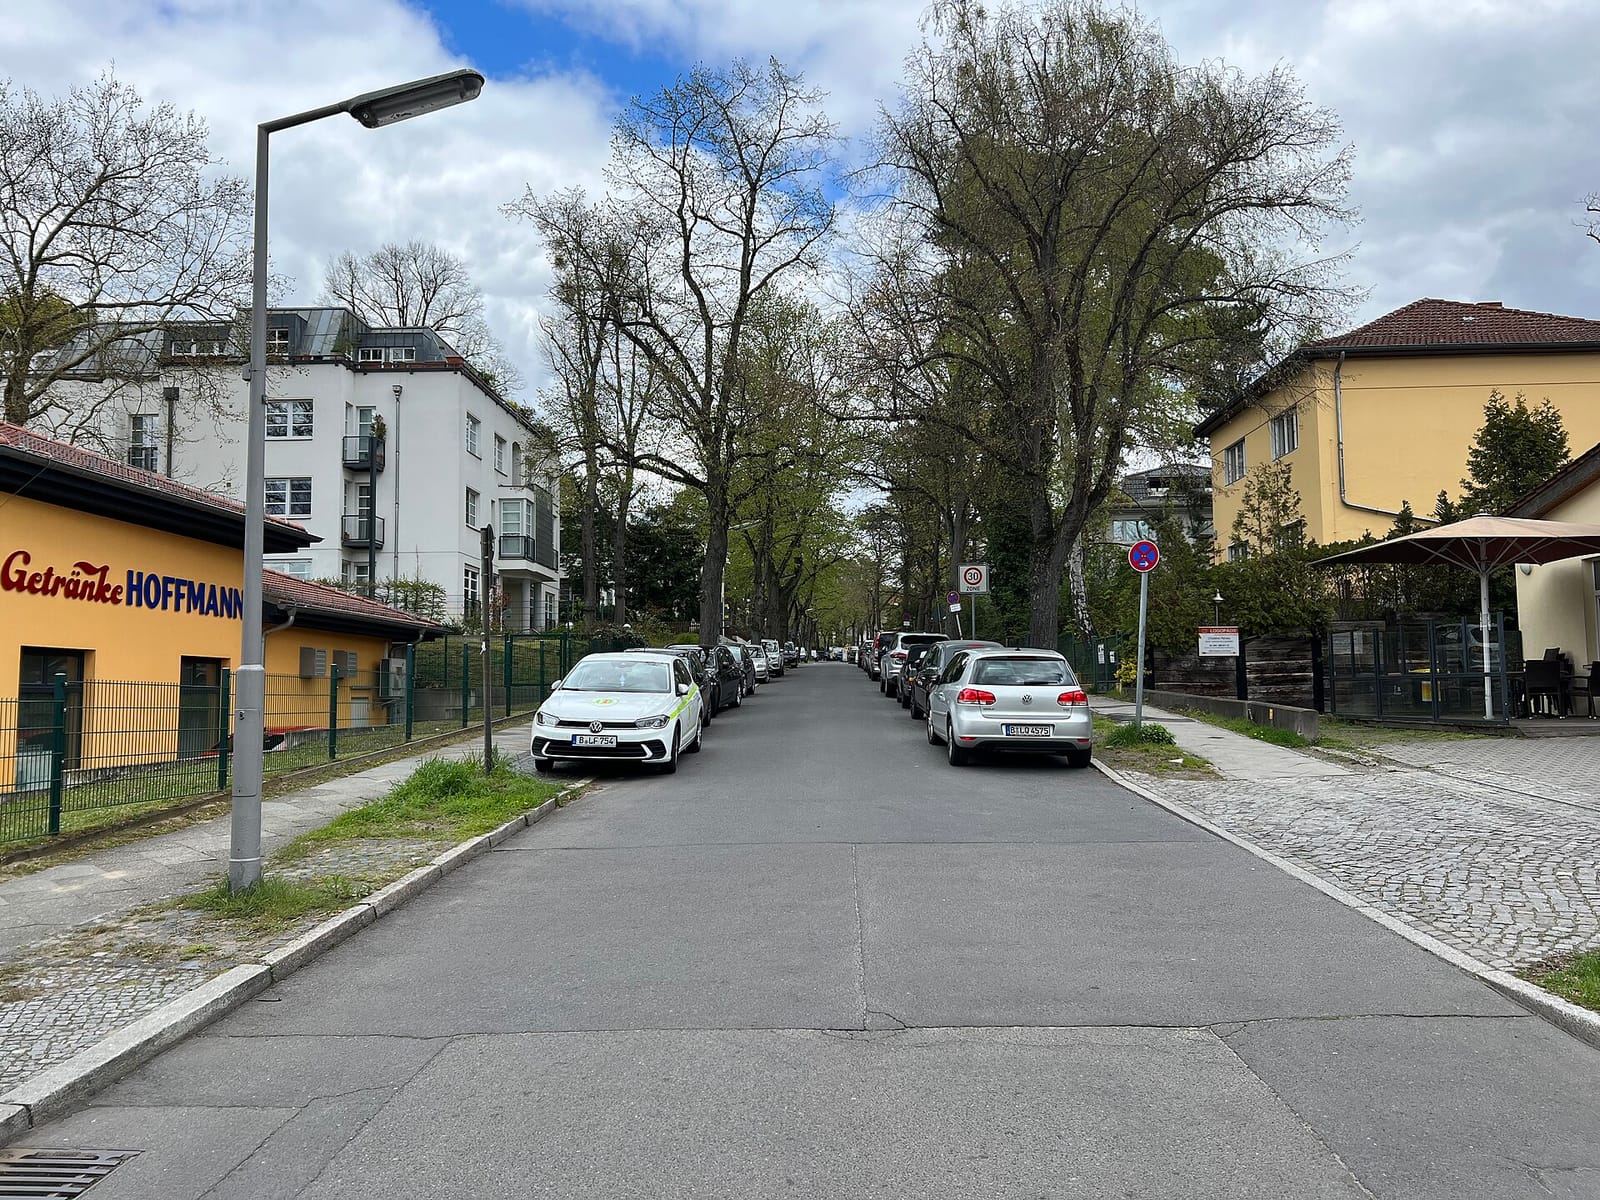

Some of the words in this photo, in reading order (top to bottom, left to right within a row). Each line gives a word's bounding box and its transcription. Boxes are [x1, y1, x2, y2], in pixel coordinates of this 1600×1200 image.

[1, 550, 124, 605] Getränke
[126, 569, 243, 620] HOFFMANN
[968, 572, 978, 580] 30
